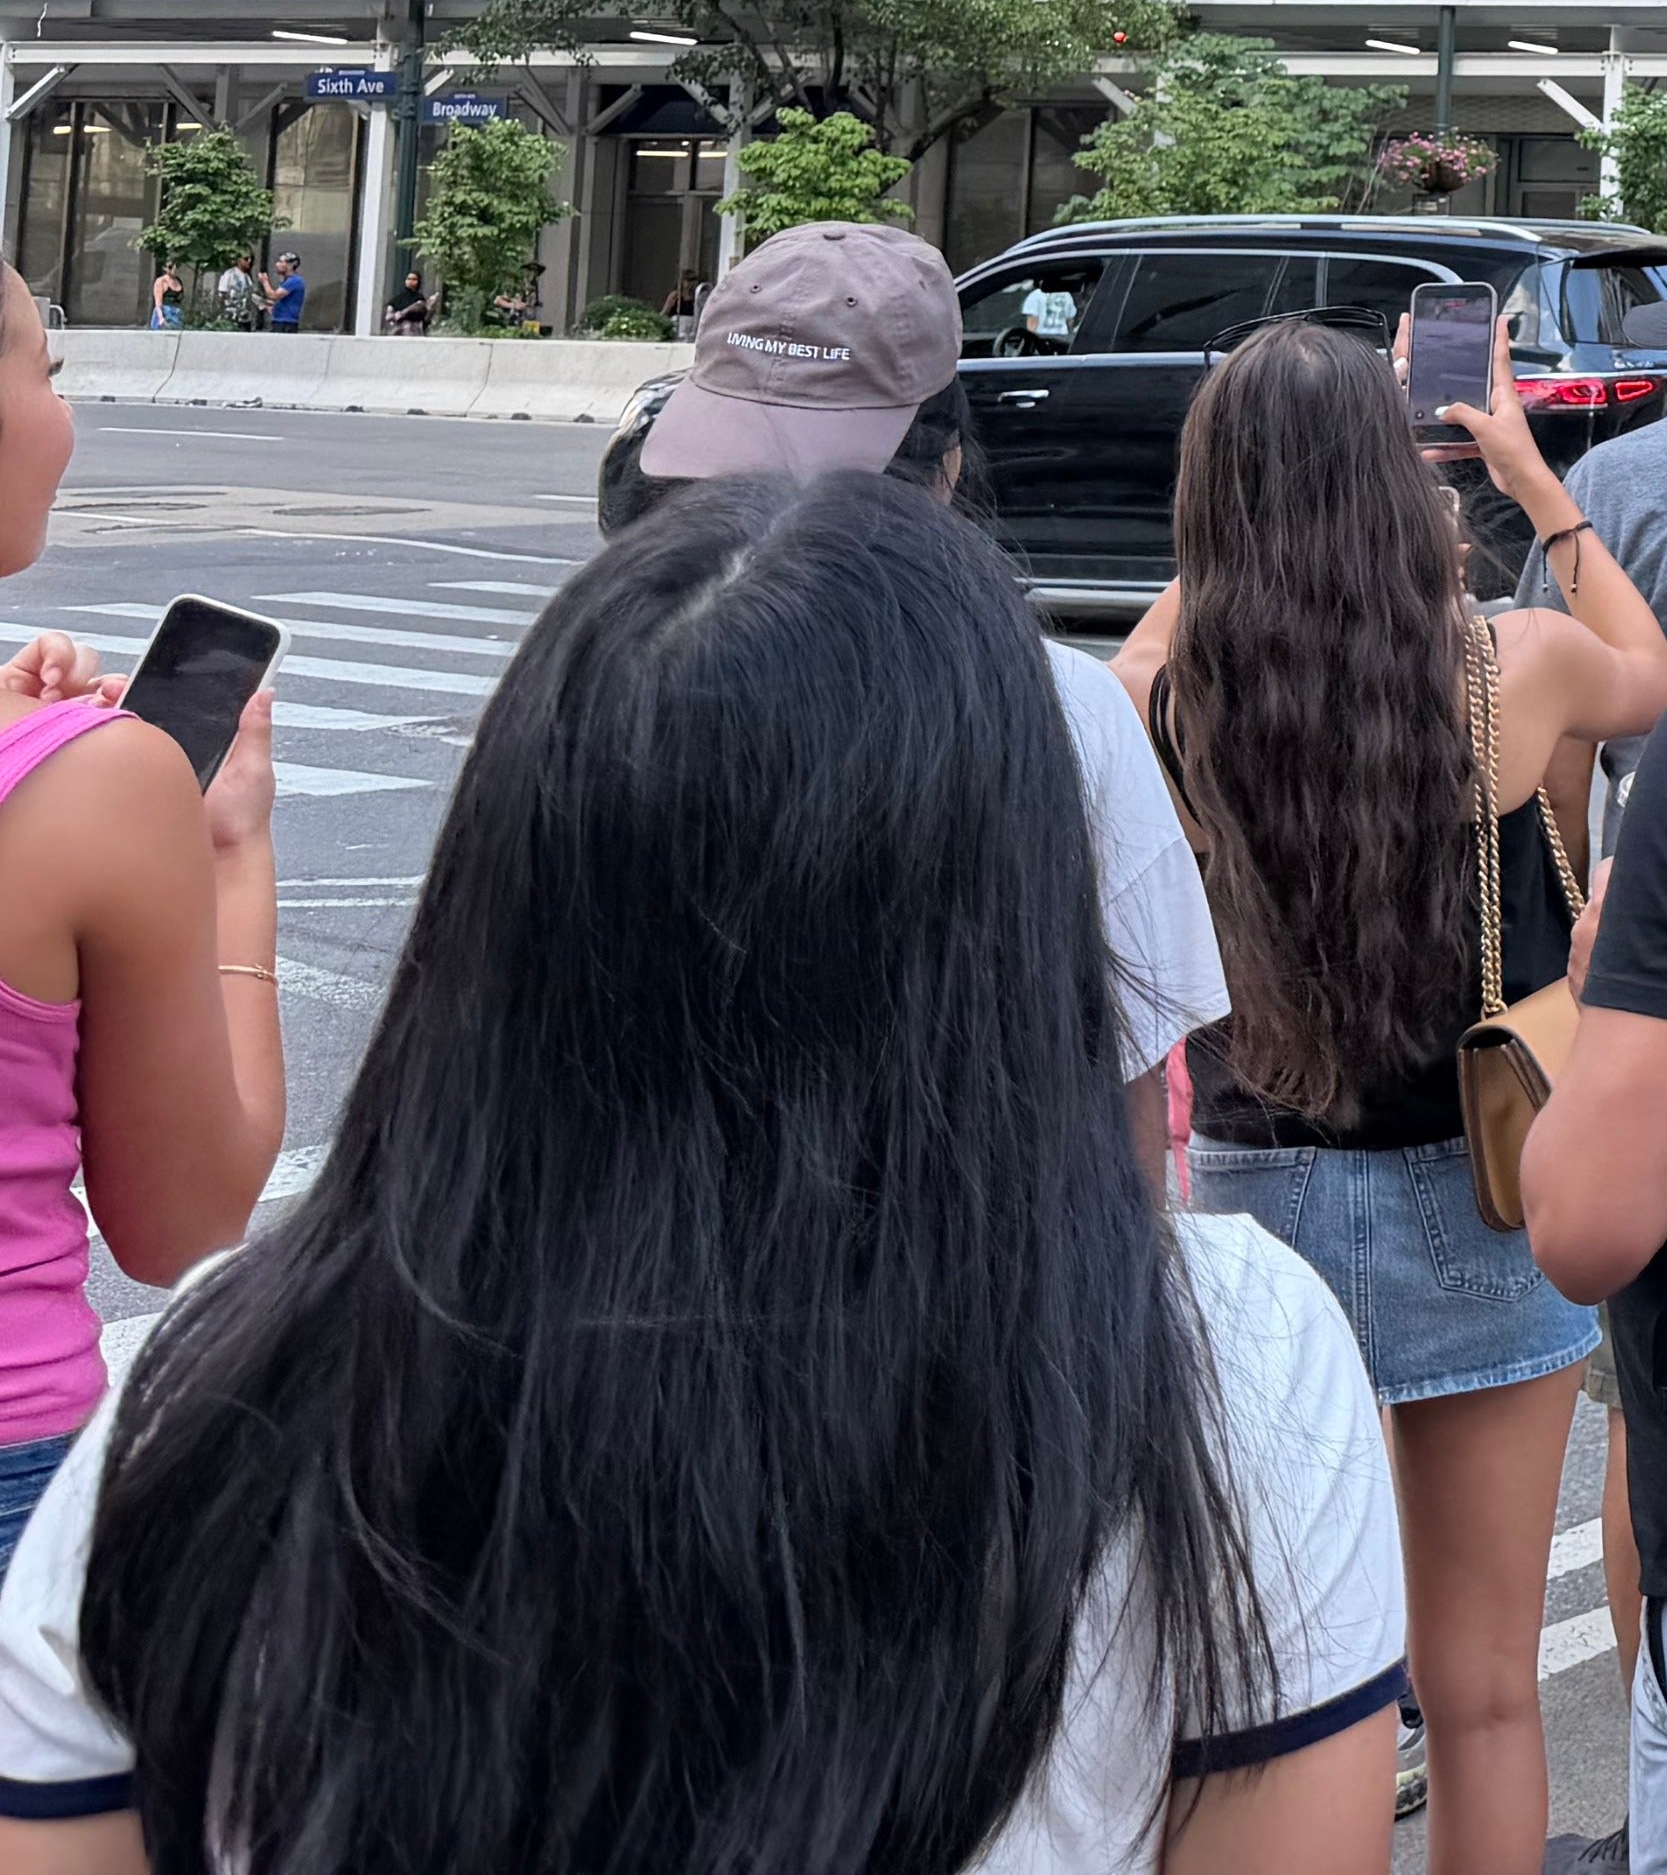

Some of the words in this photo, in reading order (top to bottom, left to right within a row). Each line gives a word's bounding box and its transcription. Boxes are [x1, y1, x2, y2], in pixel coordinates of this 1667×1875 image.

[318, 78, 352, 94] Sixth
[357, 79, 384, 94] Ave
[433, 101, 496, 120] Broadway
[727, 331, 764, 351] LIVING
[764, 338, 786, 355] MY
[788, 343, 818, 360] BEST
[823, 347, 850, 361] LIFE
